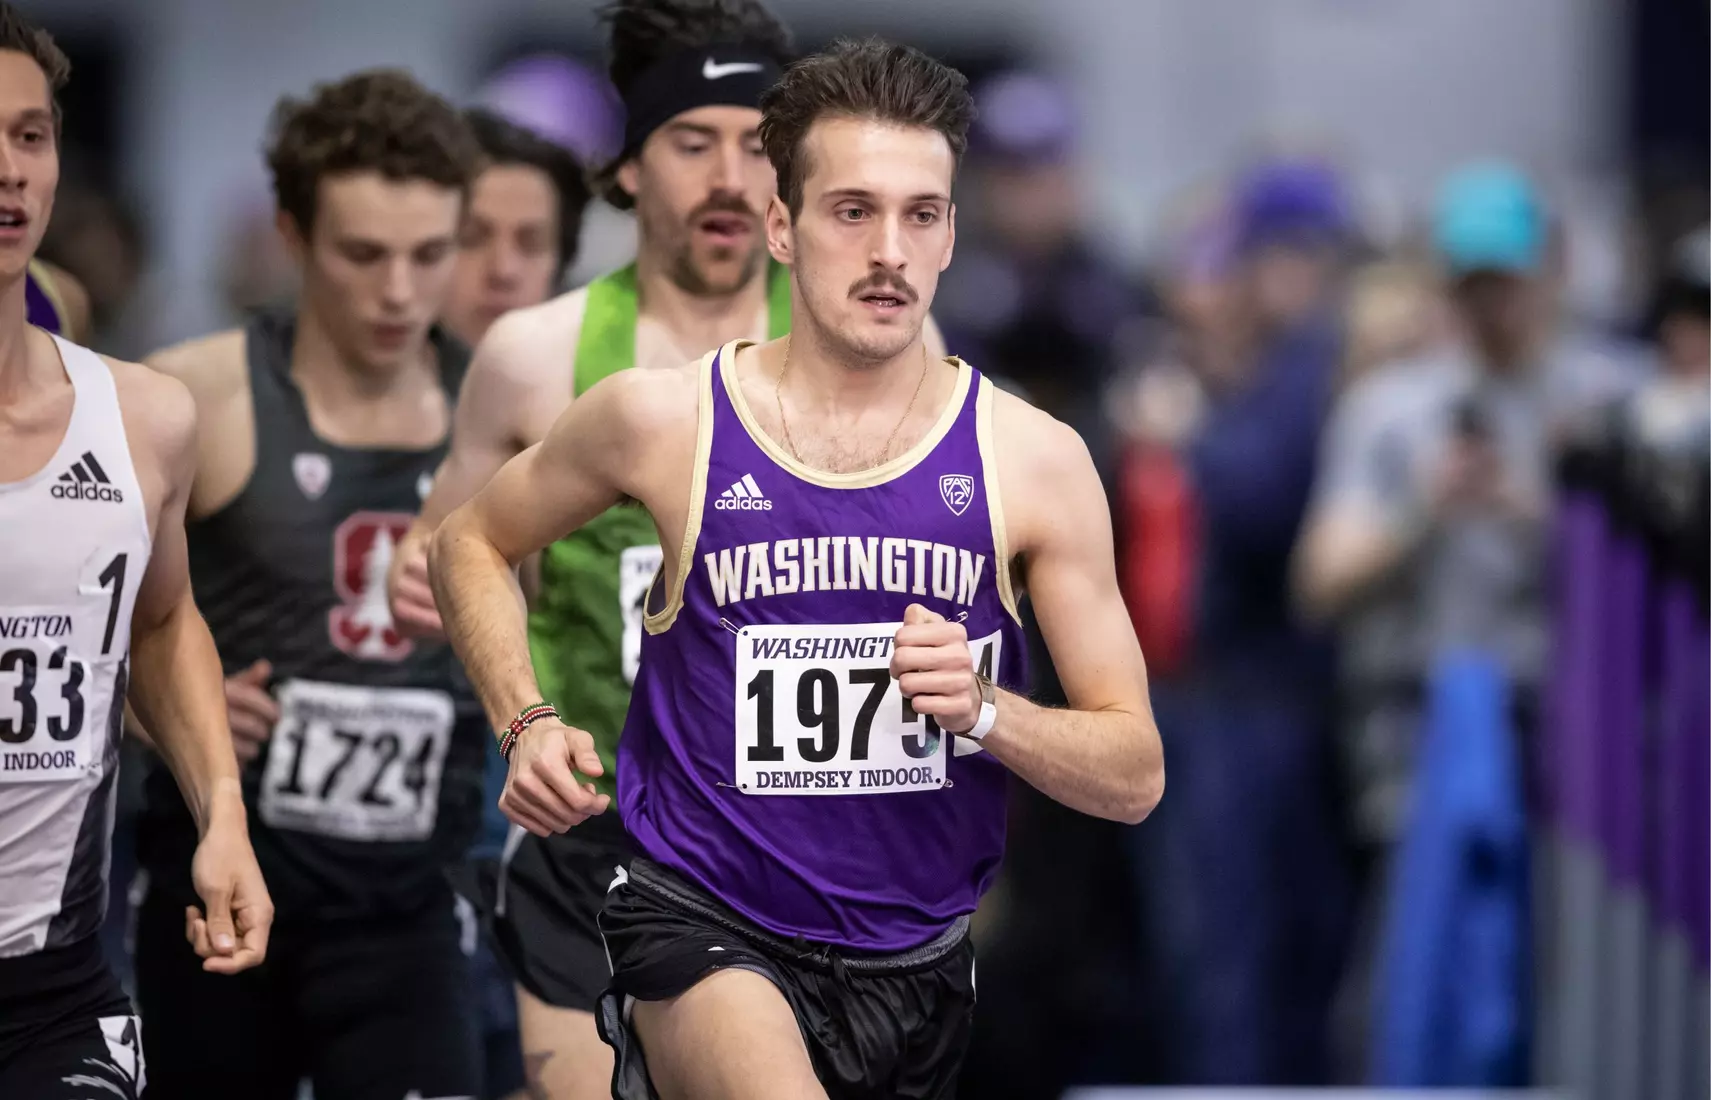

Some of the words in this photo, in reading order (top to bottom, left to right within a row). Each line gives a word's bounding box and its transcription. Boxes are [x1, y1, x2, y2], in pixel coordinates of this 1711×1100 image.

[50, 482, 123, 504] adidas
[943, 477, 971, 498] PAC
[950, 491, 965, 505] 12
[714, 496, 773, 511] adidas
[704, 536, 986, 608] WASHINGTON
[98, 552, 128, 655] 1
[751, 636, 895, 660] WASHINGT
[747, 667, 941, 763] 1975
[3, 750, 76, 771] INDOOR
[275, 721, 434, 809] 1724
[756, 770, 853, 789] DEMPSEY
[859, 766, 934, 787] INDOOR
